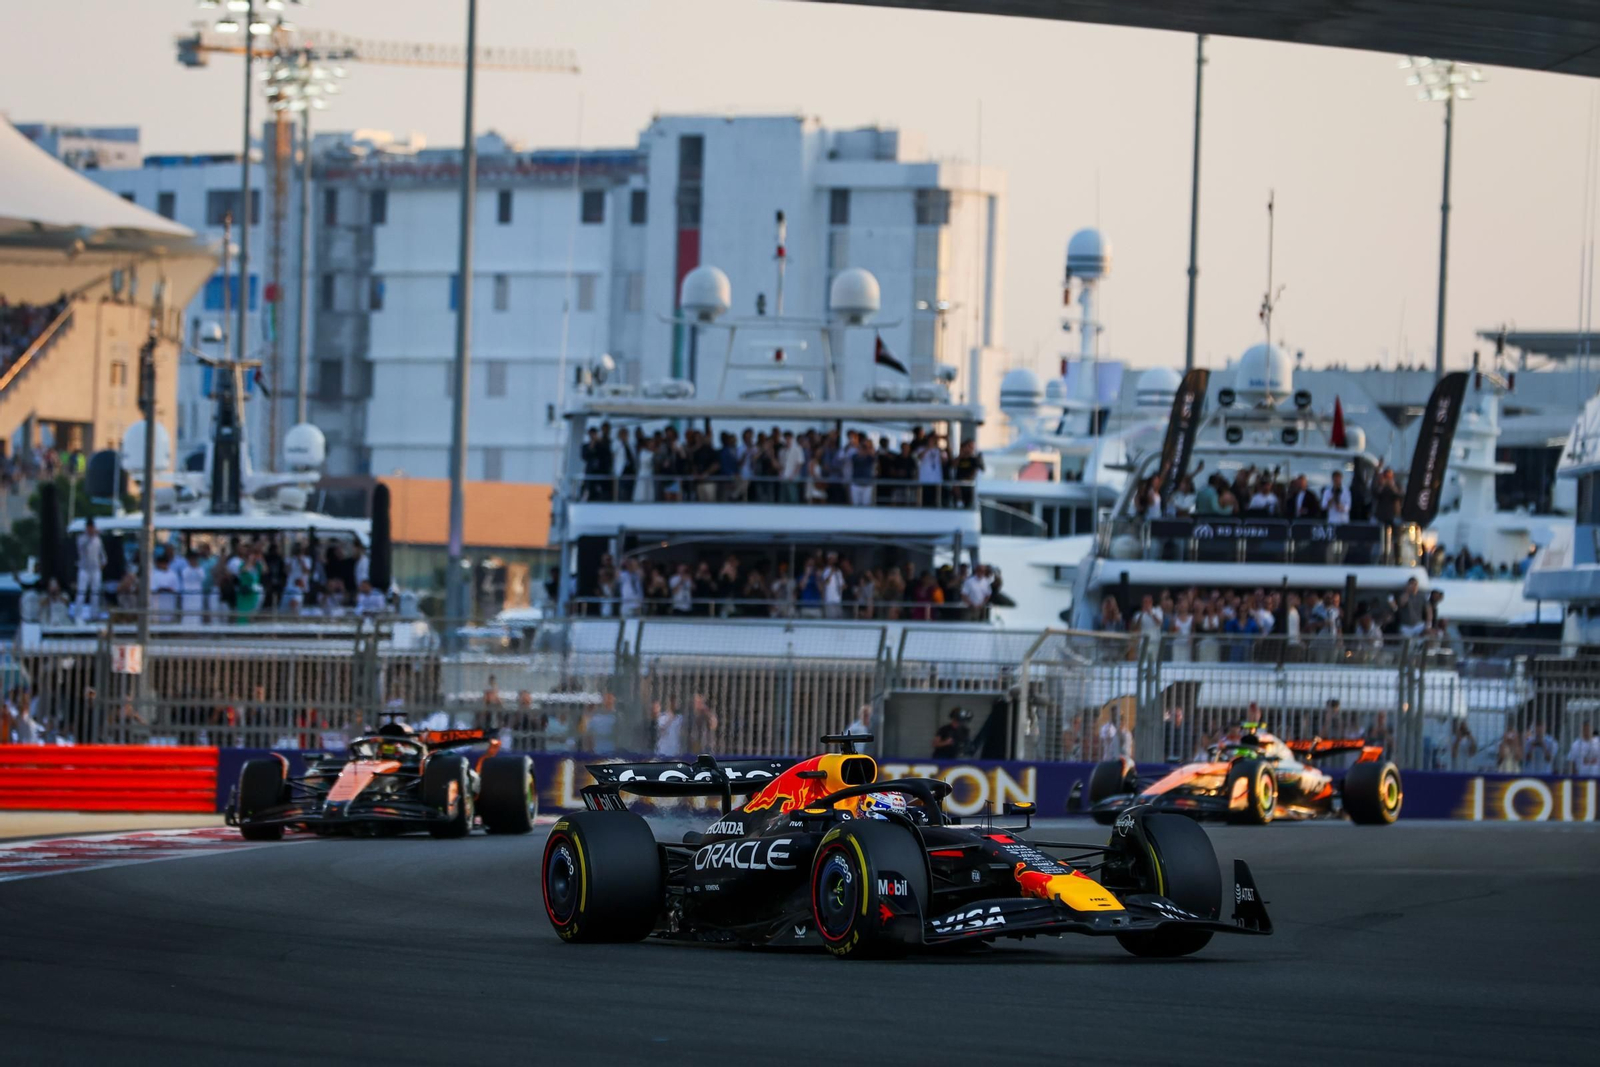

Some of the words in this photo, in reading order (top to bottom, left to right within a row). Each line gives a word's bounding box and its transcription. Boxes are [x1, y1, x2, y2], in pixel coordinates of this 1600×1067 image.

[705, 822, 745, 835] HONDA
[695, 839, 797, 870] ORACLE
[878, 879, 908, 896] Mobil
[931, 906, 1006, 934] VISA
